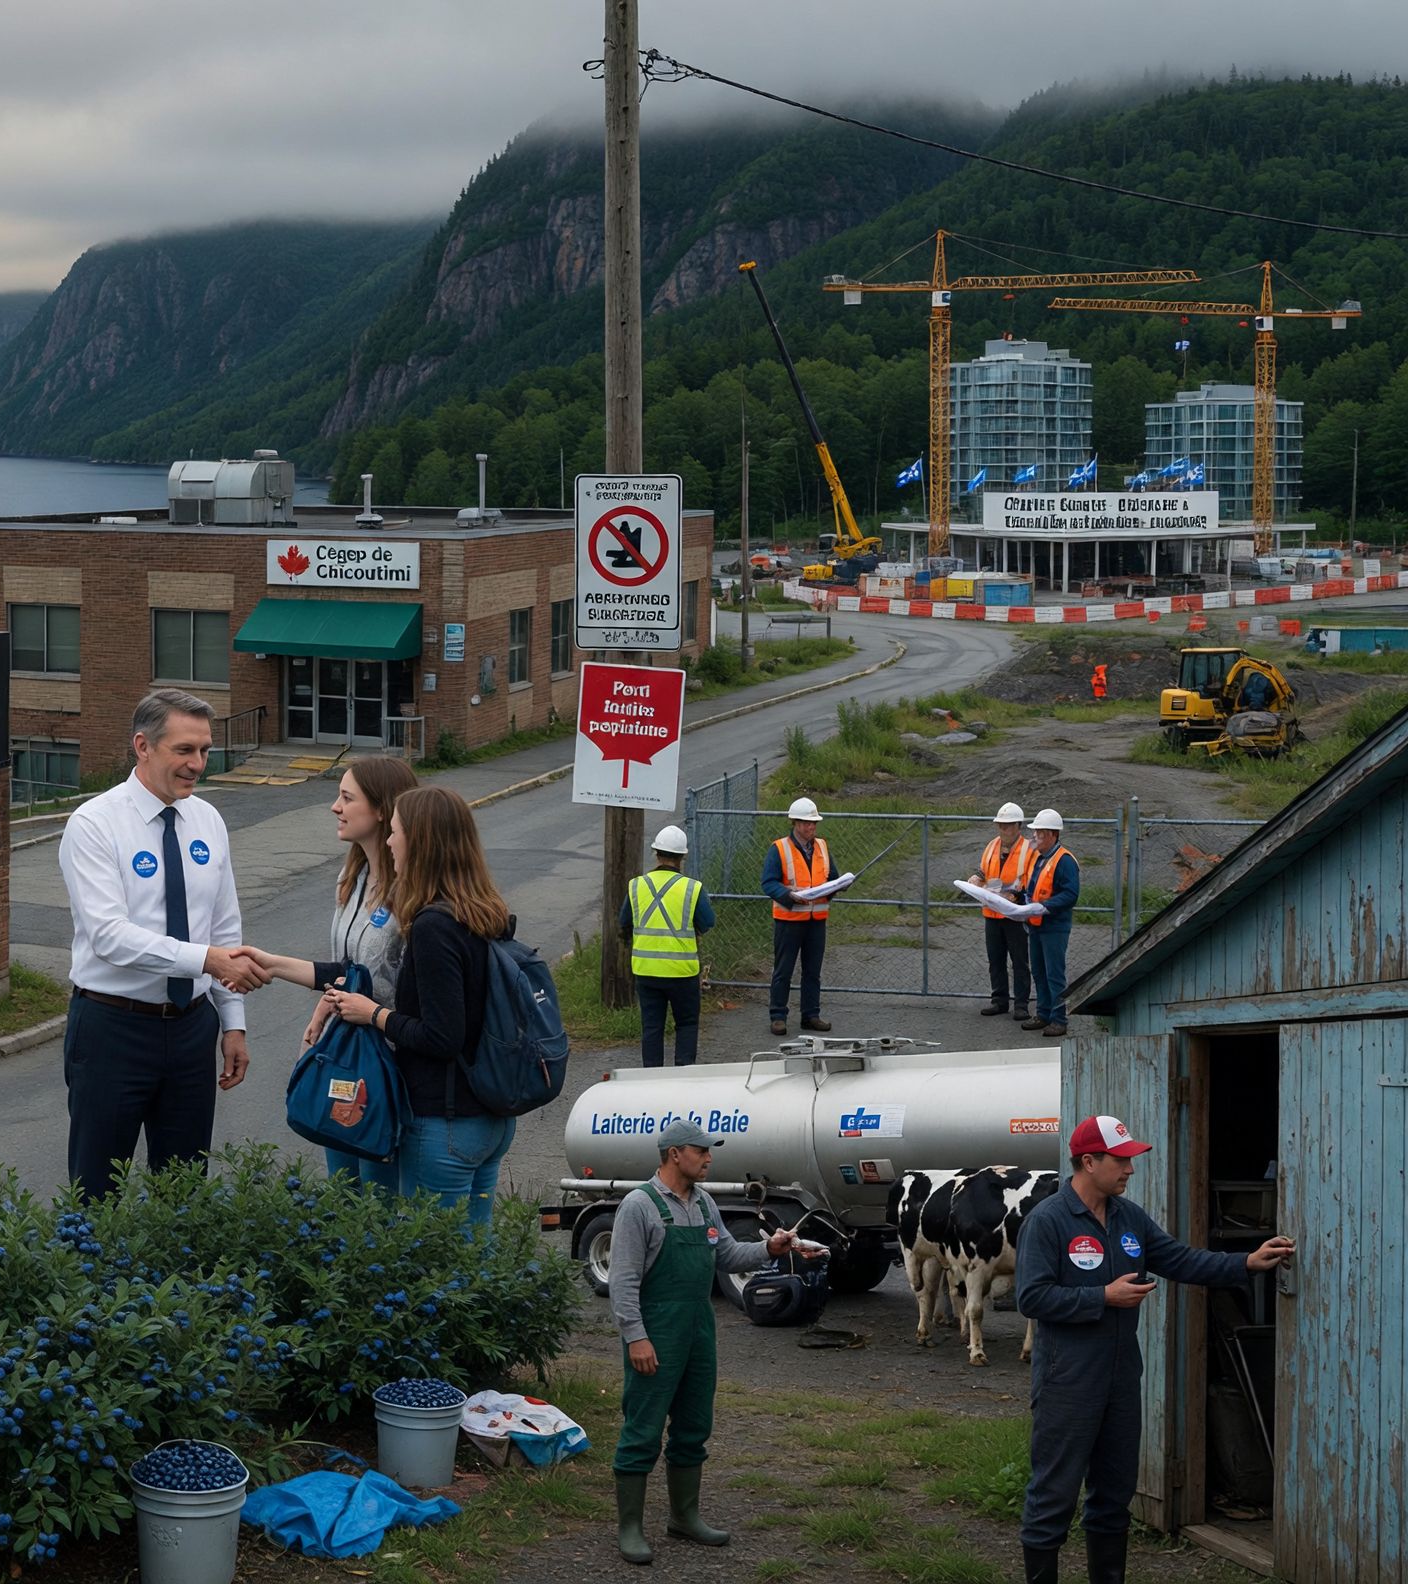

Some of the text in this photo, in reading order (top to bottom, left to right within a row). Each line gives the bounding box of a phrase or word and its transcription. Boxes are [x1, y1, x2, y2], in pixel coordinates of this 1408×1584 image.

[372, 546, 393, 562] de
[316, 564, 411, 581] Chicoutimi
[592, 1112, 655, 1134] Laiterie
[708, 1109, 749, 1133] Baie
